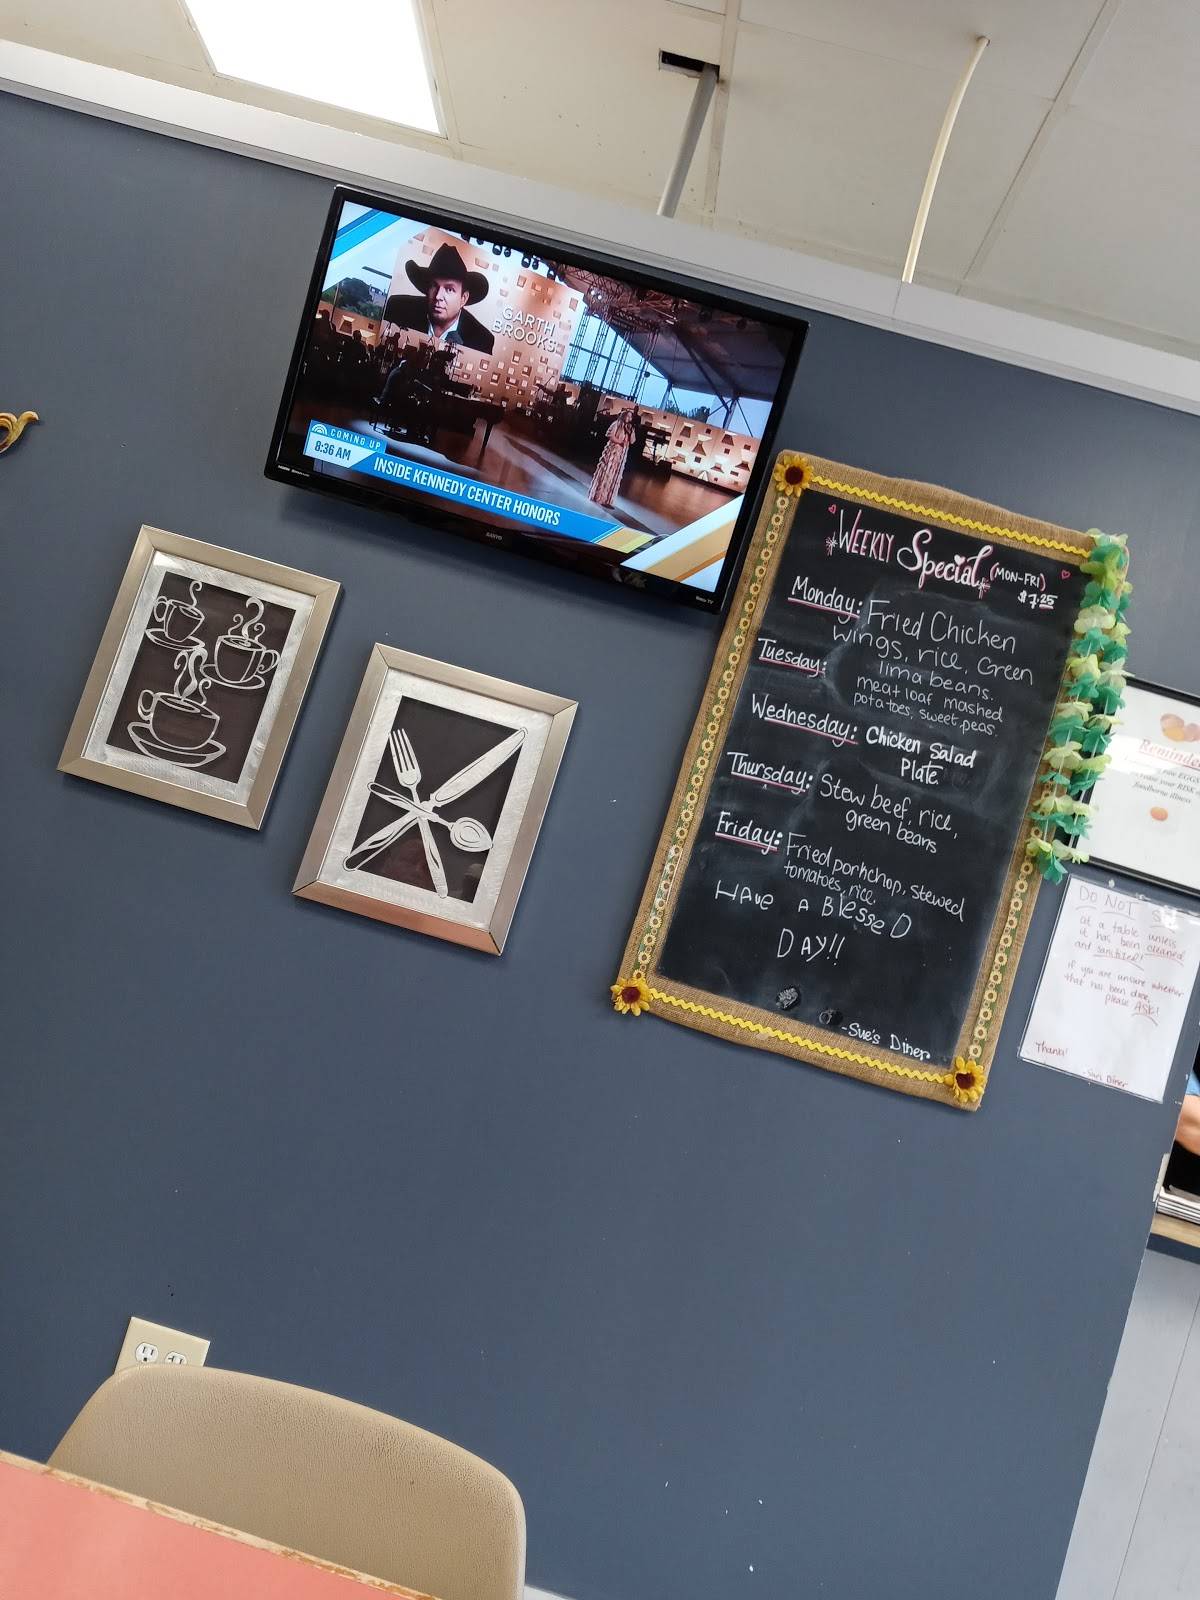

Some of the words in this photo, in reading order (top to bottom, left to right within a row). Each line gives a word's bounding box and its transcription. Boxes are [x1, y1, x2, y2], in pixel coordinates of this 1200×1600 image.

[491, 320, 557, 353] BROOKS
[502, 305, 556, 337] GARTH
[314, 441, 335, 456] 8:36
[335, 446, 352, 461] AM
[330, 428, 366, 446] COMING
[369, 442, 382, 450] UP
[374, 457, 411, 481] INSIDE
[412, 469, 467, 497] KENNEDY
[467, 486, 512, 512] CENTER
[512, 502, 562, 526] HONORS
[838, 509, 895, 563] WEEKLY
[897, 528, 994, 591] Special
[989, 563, 1047, 591] (MON-FRI)
[790, 575, 864, 625] Monday:
[867, 599, 925, 641] Fried
[930, 610, 1017, 654] Chicken
[1017, 590, 1059, 609] $7.25
[879, 661, 922, 684] lima
[918, 647, 968, 675] rice,
[757, 637, 828, 678] Tuesday:
[943, 697, 1004, 723] mashed
[751, 692, 858, 748] Wednesday:
[865, 726, 921, 755] Chicken
[929, 743, 977, 768] Salad
[920, 708, 958, 727] sweet
[1140, 738, 1200, 767] Reminde
[726, 751, 814, 795] Thursday:
[820, 773, 866, 807] Stew
[918, 809, 959, 840] rice,
[715, 811, 784, 856] Friday:
[786, 832, 833, 867] Fried
[845, 809, 891, 834] green
[896, 822, 938, 854] beans
[798, 898, 809, 912] A
[776, 927, 846, 966] DAY!!
[889, 1034, 932, 1061] Diner
